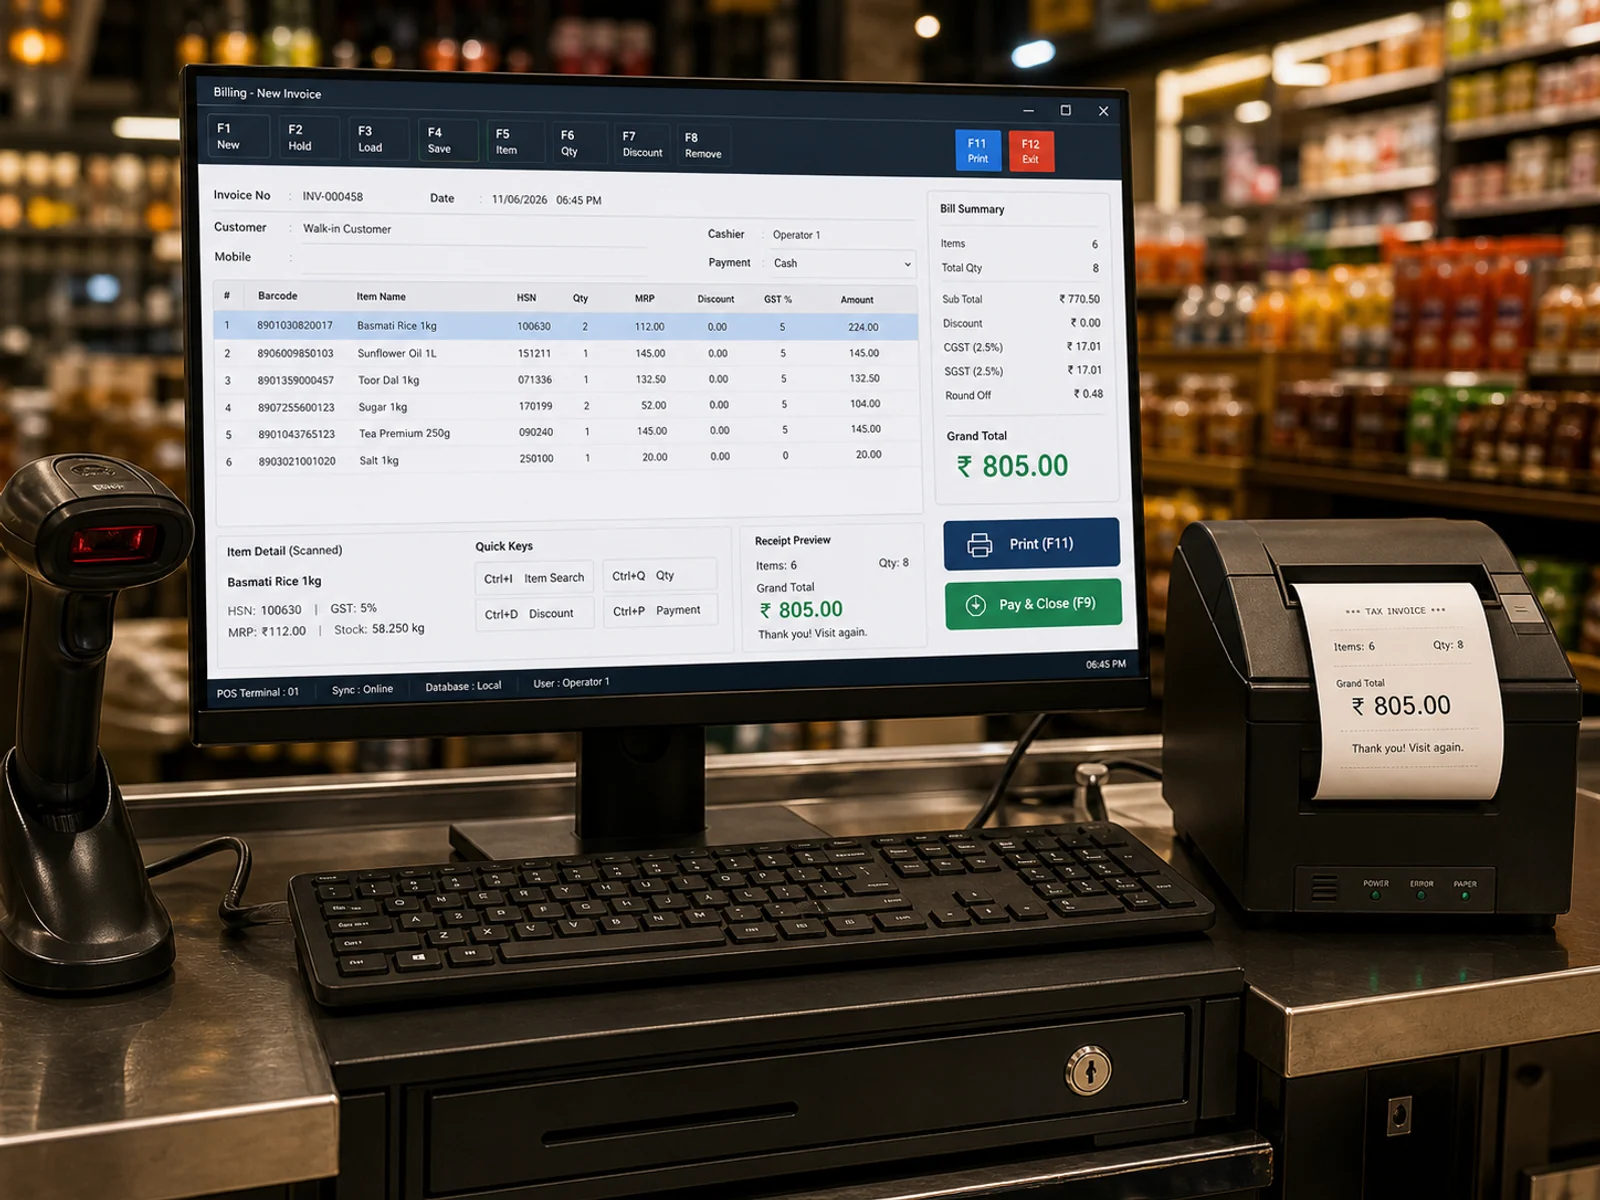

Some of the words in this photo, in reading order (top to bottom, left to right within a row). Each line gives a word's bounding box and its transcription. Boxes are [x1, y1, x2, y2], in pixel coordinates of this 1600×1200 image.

[214, 87, 247, 100] Billing
[257, 88, 281, 98] New
[284, 89, 322, 99] Invoice
[217, 123, 230, 133] F1
[289, 124, 302, 135] F2
[358, 126, 372, 136] F3
[428, 127, 442, 137] F4
[217, 140, 240, 149] New
[289, 141, 312, 151] Hold
[359, 143, 382, 152] Load
[968, 138, 985, 148] F11
[1022, 139, 1040, 149] F12
[428, 144, 451, 153] Save
[968, 154, 988, 163] Print
[1022, 154, 1039, 164] Exit
[214, 190, 252, 200] Invoice
[255, 190, 271, 200] No
[303, 191, 363, 202] INV-000458
[430, 193, 455, 203] Date
[493, 195, 548, 205] 11/06/2026
[556, 195, 583, 205] 06:45
[586, 196, 602, 205] PM
[940, 204, 955, 213] Bill
[958, 204, 1005, 216] Summary
[214, 221, 267, 232] Customer
[303, 224, 340, 233] Walk-in
[343, 224, 391, 234] Customer
[708, 228, 745, 239] Cashier
[773, 229, 813, 241] Operator
[816, 231, 820, 239] 1
[941, 239, 966, 248] Items
[1092, 239, 1098, 249] 6
[215, 252, 251, 262] Mobile
[709, 257, 751, 269] Payment
[774, 258, 797, 268] Cash
[1093, 263, 1099, 273] 8
[942, 263, 964, 272] Total
[966, 263, 982, 274] Qty
[224, 291, 230, 299] #
[258, 291, 298, 300] Barcode
[357, 292, 377, 301] Item
[380, 292, 406, 301] Name
[517, 293, 536, 302] HSN
[573, 293, 588, 304] Qty
[635, 294, 655, 302] MRP
[698, 294, 735, 303] Discount
[764, 295, 782, 303] GST
[784, 295, 792, 303] %
[841, 296, 874, 304] Amount
[942, 294, 960, 304] Sub
[961, 294, 982, 304] Total
[1068, 294, 1100, 304] 770.50
[257, 320, 333, 330] 8901030820017
[357, 321, 395, 330] Basmati
[398, 321, 417, 330] Rice
[421, 321, 437, 332] 1kg
[518, 321, 551, 331] 100630
[636, 322, 665, 331] 112.00
[849, 323, 879, 332] 224.00
[943, 318, 983, 328] Discount
[1080, 318, 1101, 328] 0.00
[944, 342, 970, 352] CGST
[973, 342, 1003, 354] (2.5%)
[1076, 341, 1100, 351] 17.01
[257, 348, 334, 358] 8906009850103
[358, 348, 406, 358] Sunflower
[409, 348, 422, 358] Oil
[426, 349, 437, 358] 1L
[519, 349, 550, 358] 151211
[636, 349, 666, 358] 145.00
[850, 348, 880, 357] 145.00
[258, 376, 334, 385] 8901359000457
[358, 375, 380, 385] Toor
[383, 375, 399, 385] Dal
[403, 376, 419, 387] 1kg
[850, 374, 880, 383] 132.50
[946, 391, 975, 400] Round
[977, 390, 991, 400] Off
[1083, 389, 1103, 399] 0.48
[947, 431, 979, 441] Grand
[981, 430, 1007, 440] Total
[957, 455, 972, 478] ₹
[983, 454, 1068, 477] 805.00
[755, 536, 791, 547] Receipt
[793, 535, 831, 545] Preview
[1010, 538, 1039, 550] Print
[1042, 536, 1073, 552] (F11)
[227, 547, 251, 557] Item
[255, 546, 286, 556] Detail
[289, 545, 342, 557] (Scanned)
[475, 541, 506, 553] Quick
[508, 541, 533, 553] Keys
[879, 558, 899, 570] Qty:
[903, 557, 909, 567] 8
[484, 574, 513, 584] Ctrl+I
[525, 574, 547, 583] Item
[550, 572, 584, 583] Search
[612, 570, 645, 581] Ctrl+Q
[656, 570, 674, 582] Qty
[757, 583, 787, 593] Grand
[790, 582, 815, 592] Total
[228, 606, 255, 616] HSN:
[261, 604, 302, 615] 100630
[331, 603, 356, 614] GST:
[361, 603, 377, 613] 5%
[761, 603, 771, 619] ₹
[779, 600, 843, 618] 805.00
[1000, 599, 1022, 613] Pay
[1024, 598, 1034, 610] &
[1036, 597, 1070, 609] Close
[1073, 596, 1096, 611] (F9)
[1387, 607, 1426, 615] INVOICE
[229, 627, 257, 637] MRP:
[262, 626, 306, 636] ₹112.00
[334, 624, 367, 635] Stock:
[372, 623, 409, 634] 58.250
[412, 623, 425, 635] kg
[1334, 643, 1364, 651] Items:
[1369, 641, 1375, 651] 6
[1433, 640, 1453, 651] Qty:
[1457, 640, 1464, 649] 8
[1112, 659, 1126, 668] PM
[534, 679, 555, 688] User
[562, 678, 602, 689] Operator
[605, 677, 609, 685] 1
[1336, 679, 1362, 688] Grand
[1364, 678, 1385, 687] Total
[217, 689, 237, 698] POS
[239, 687, 280, 698] Terminal
[288, 687, 298, 696] 01
[332, 686, 355, 697] Sync
[363, 684, 393, 694] Online
[1352, 698, 1364, 716] ₹
[1375, 695, 1450, 716] 805.00
[1352, 744, 1382, 753] Thank
[1385, 743, 1405, 755] you!
[1409, 742, 1431, 752] Visit
[1434, 742, 1464, 754] again.
